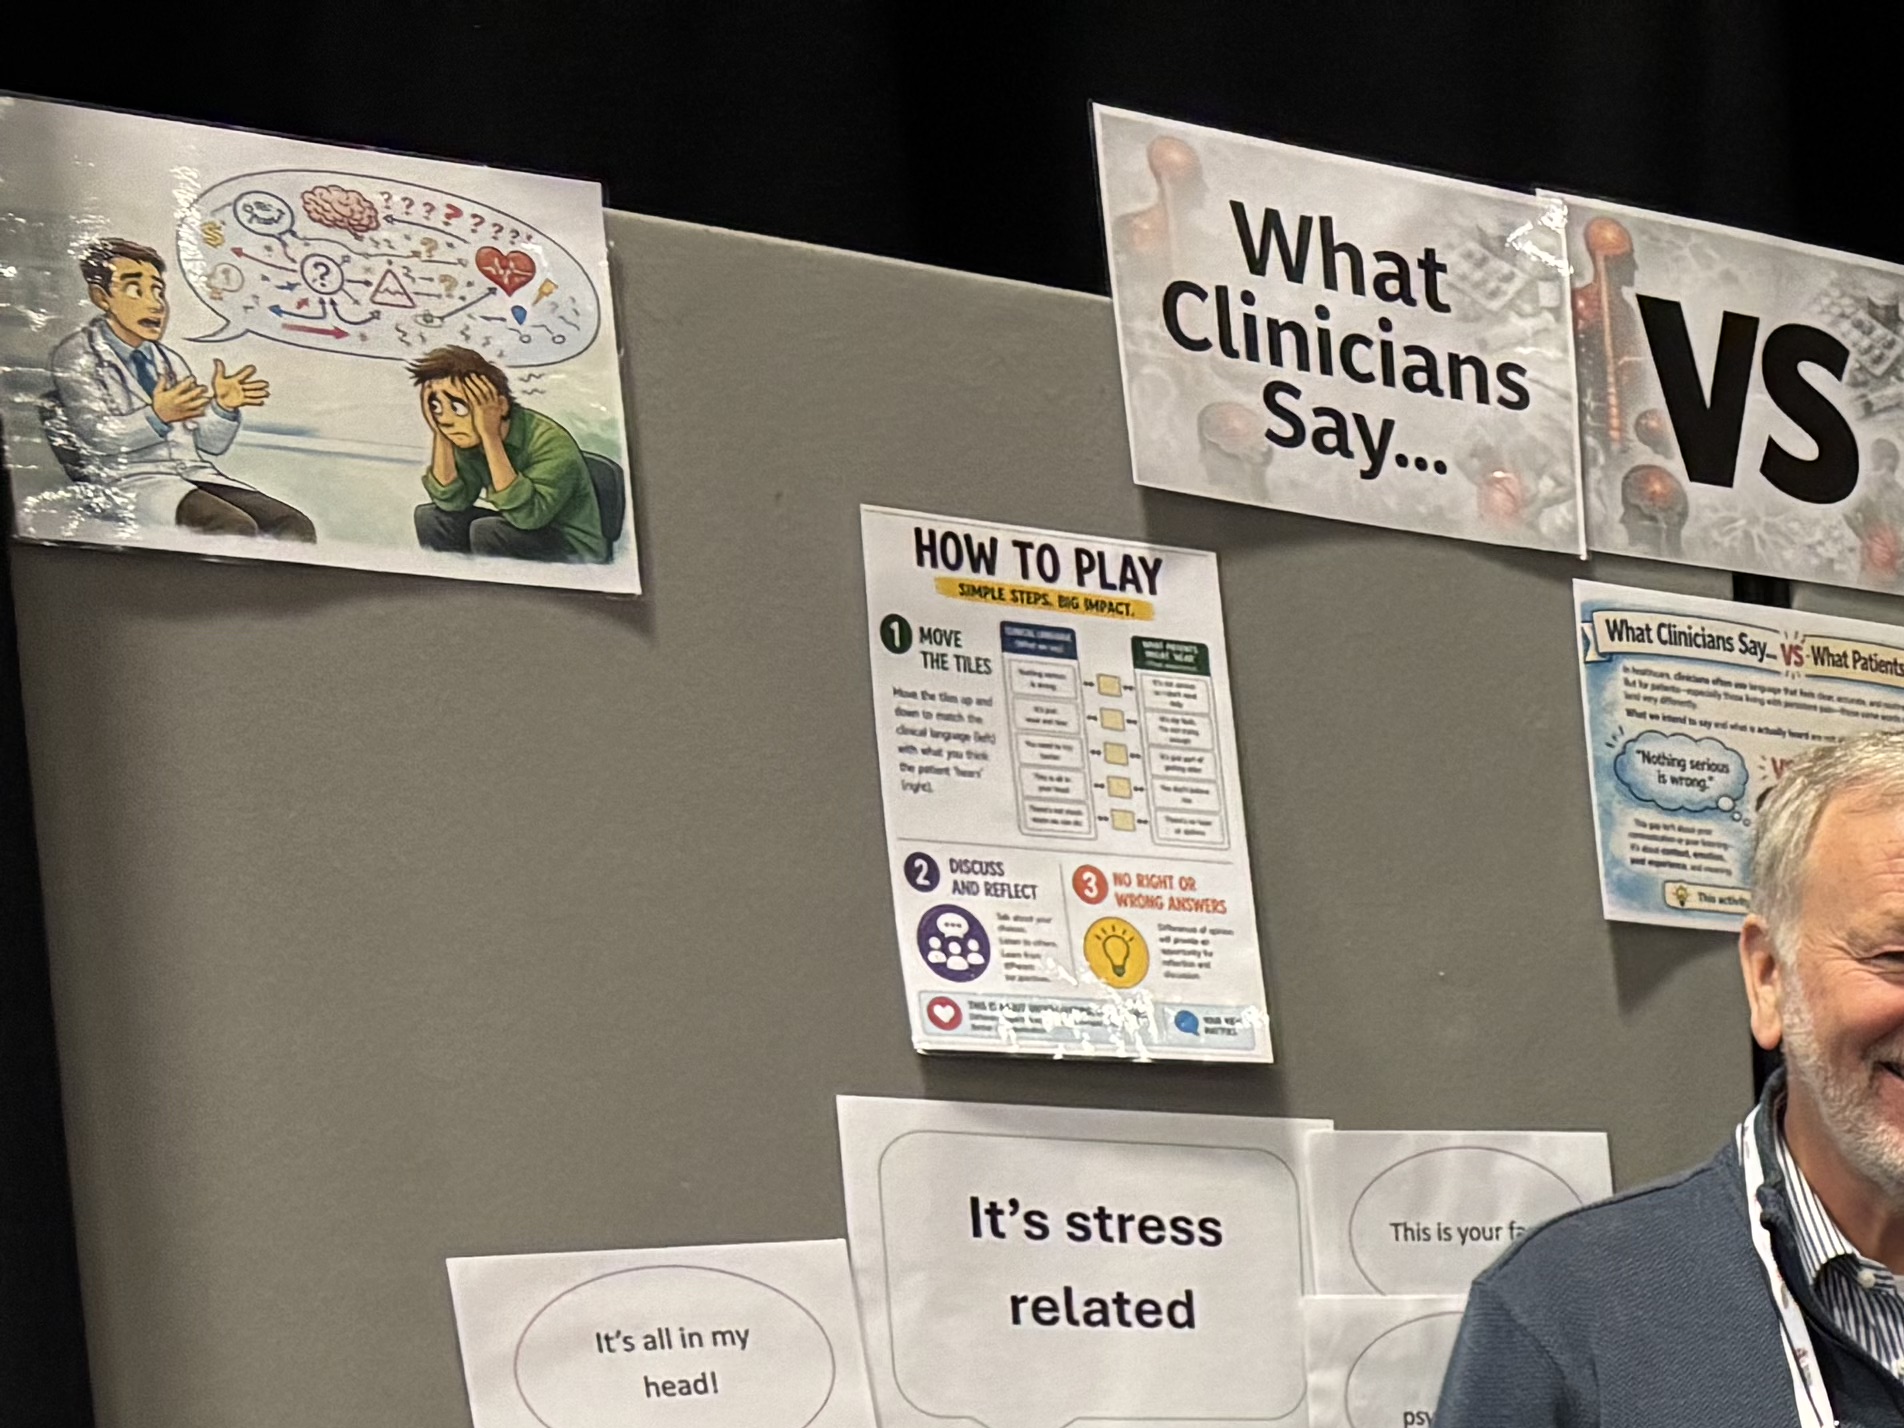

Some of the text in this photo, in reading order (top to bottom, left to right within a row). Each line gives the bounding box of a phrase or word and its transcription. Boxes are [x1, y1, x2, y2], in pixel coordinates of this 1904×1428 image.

[1230, 200, 1451, 320] What
[1162, 263, 1529, 427] Clinicians
[1636, 294, 1859, 504] VS
[1263, 381, 1447, 480] Say...
[914, 527, 1162, 595] HOW TO PLAY
[919, 627, 962, 648] MOVE
[1605, 619, 1653, 643] What
[1657, 623, 1734, 652] Clinicians
[920, 651, 992, 675] THE TILES
[1780, 643, 1804, 667] VS
[1811, 645, 1849, 669] What
[970, 1196, 1222, 1247] It's stress
[1011, 1286, 1195, 1328] related
[596, 1327, 749, 1353] It's all in my
[644, 1371, 718, 1398] head!
